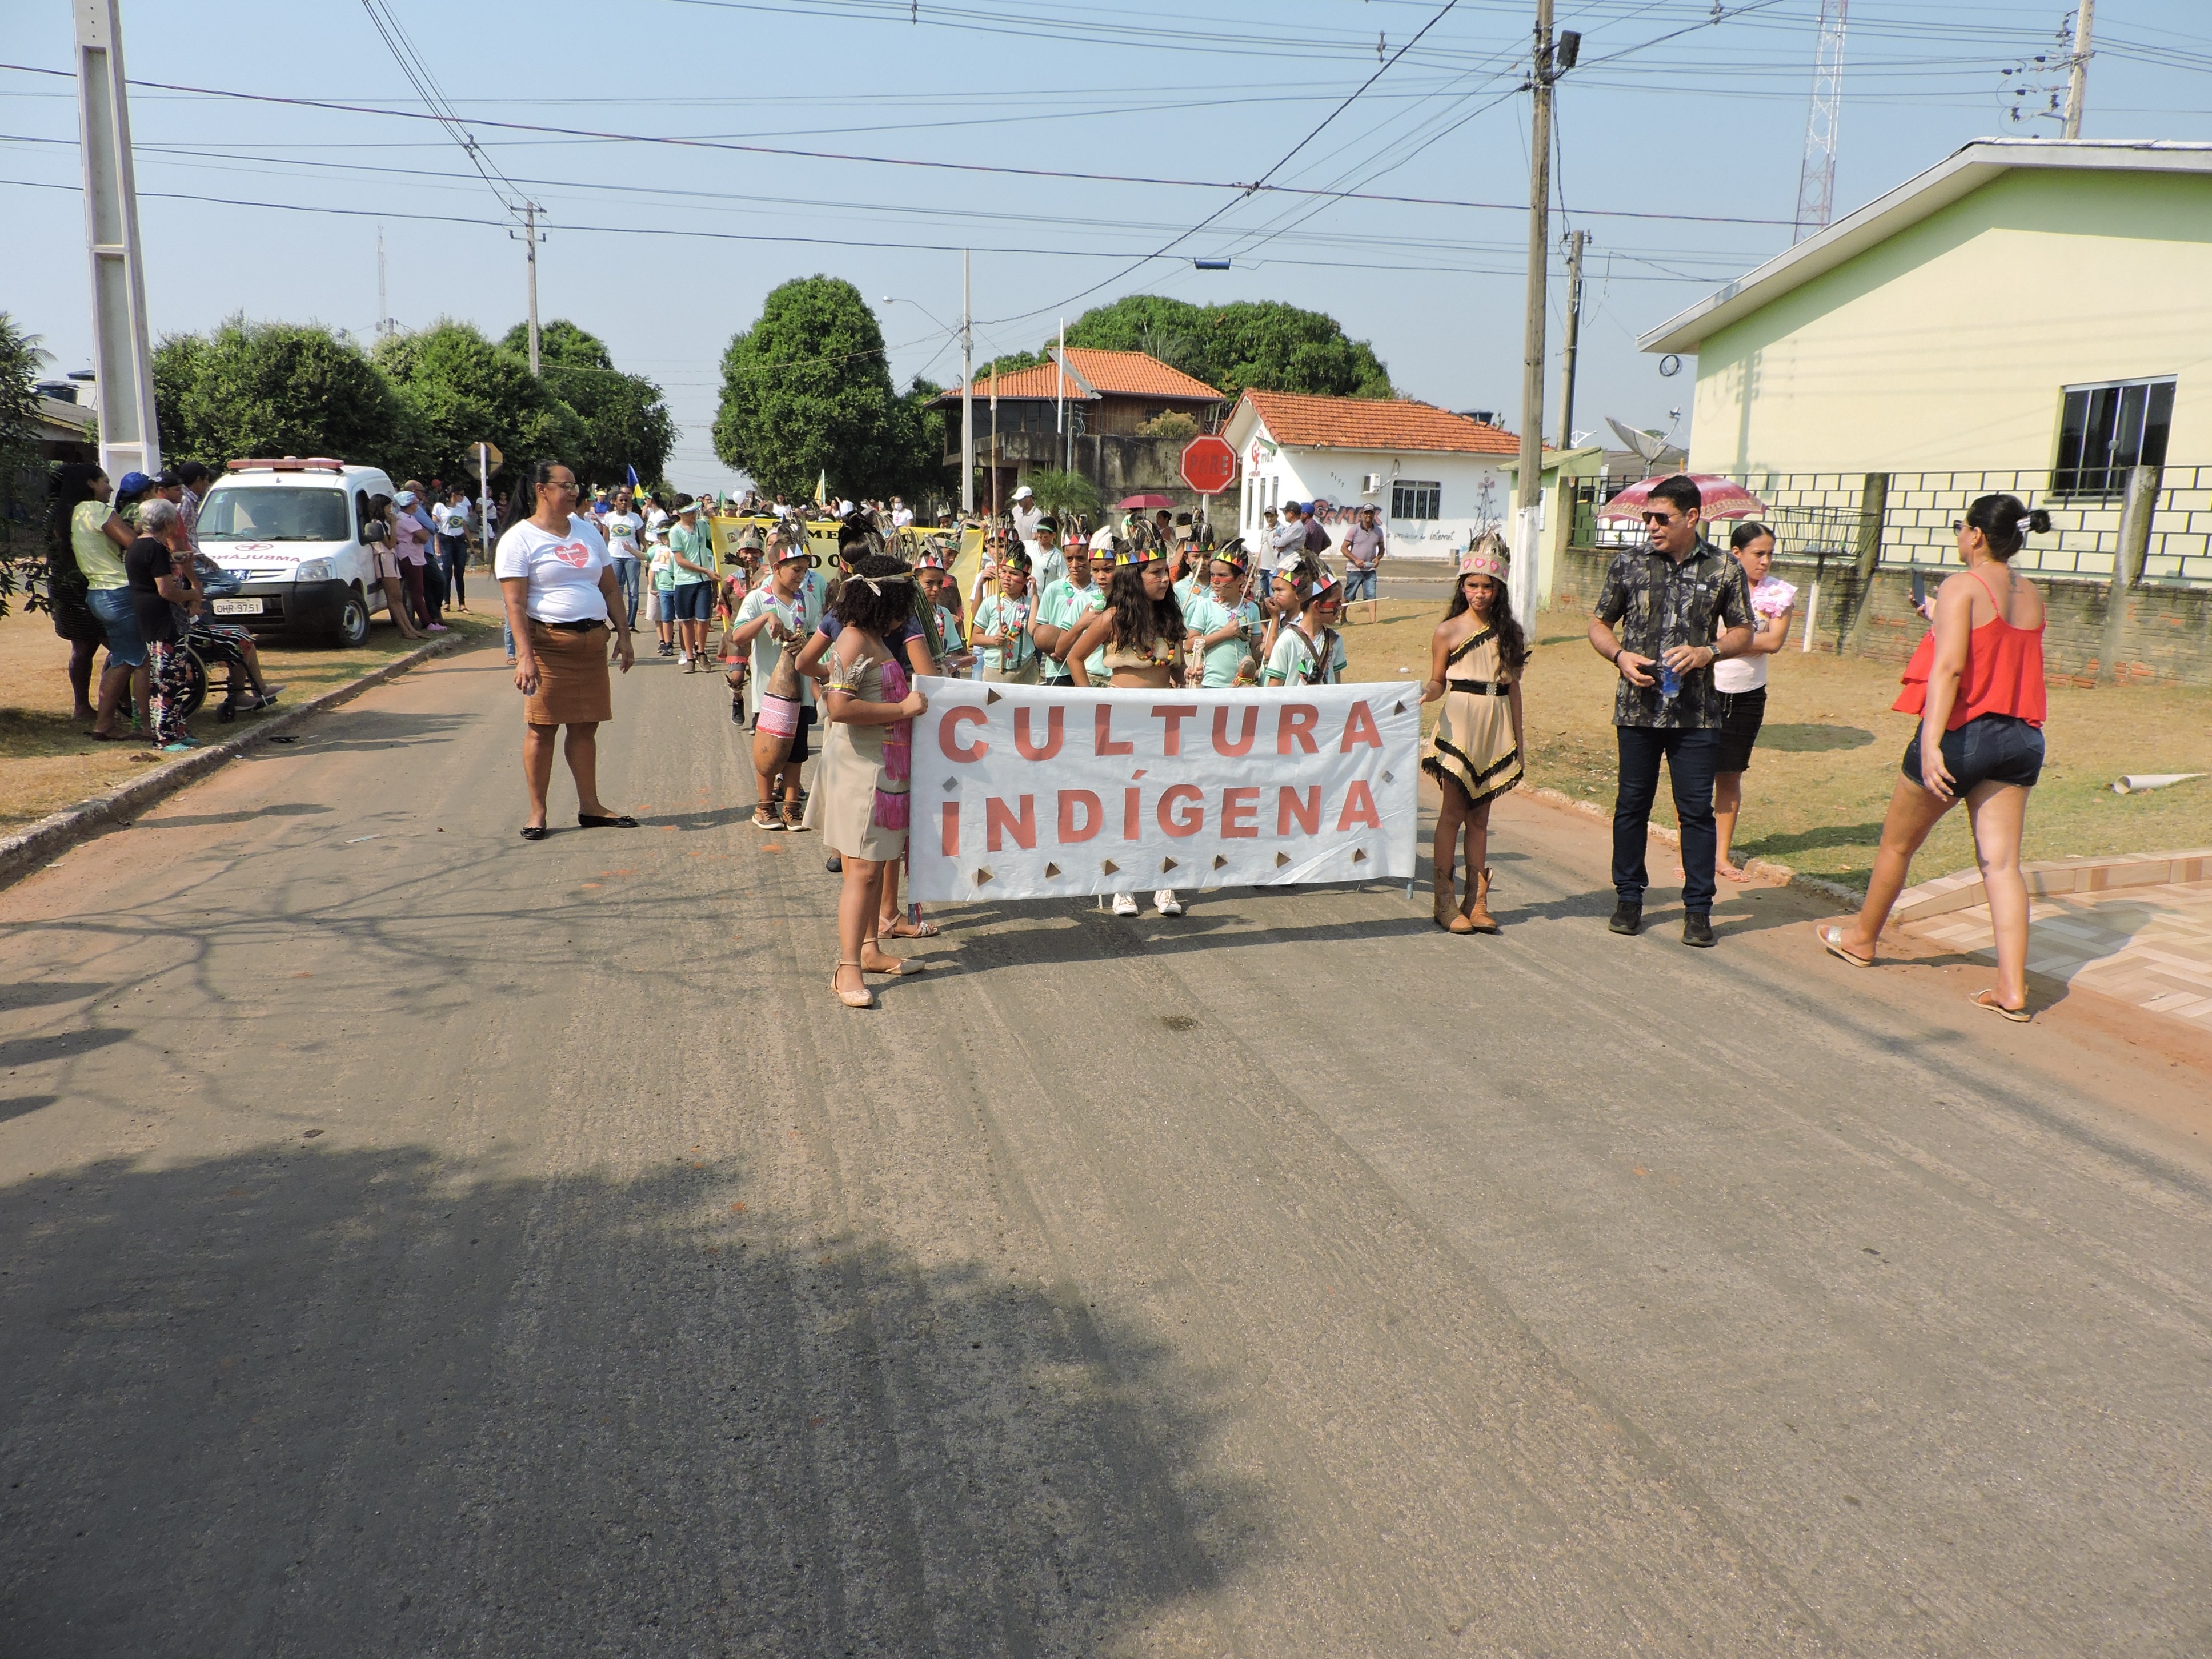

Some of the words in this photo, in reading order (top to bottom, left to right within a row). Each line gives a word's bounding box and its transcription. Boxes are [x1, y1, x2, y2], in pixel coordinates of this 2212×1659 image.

[1189, 454, 1228, 475] PARE
[1429, 529, 1456, 540] internet
[938, 700, 1383, 763] CULTURA
[941, 770, 1384, 857] INDÍGENA
